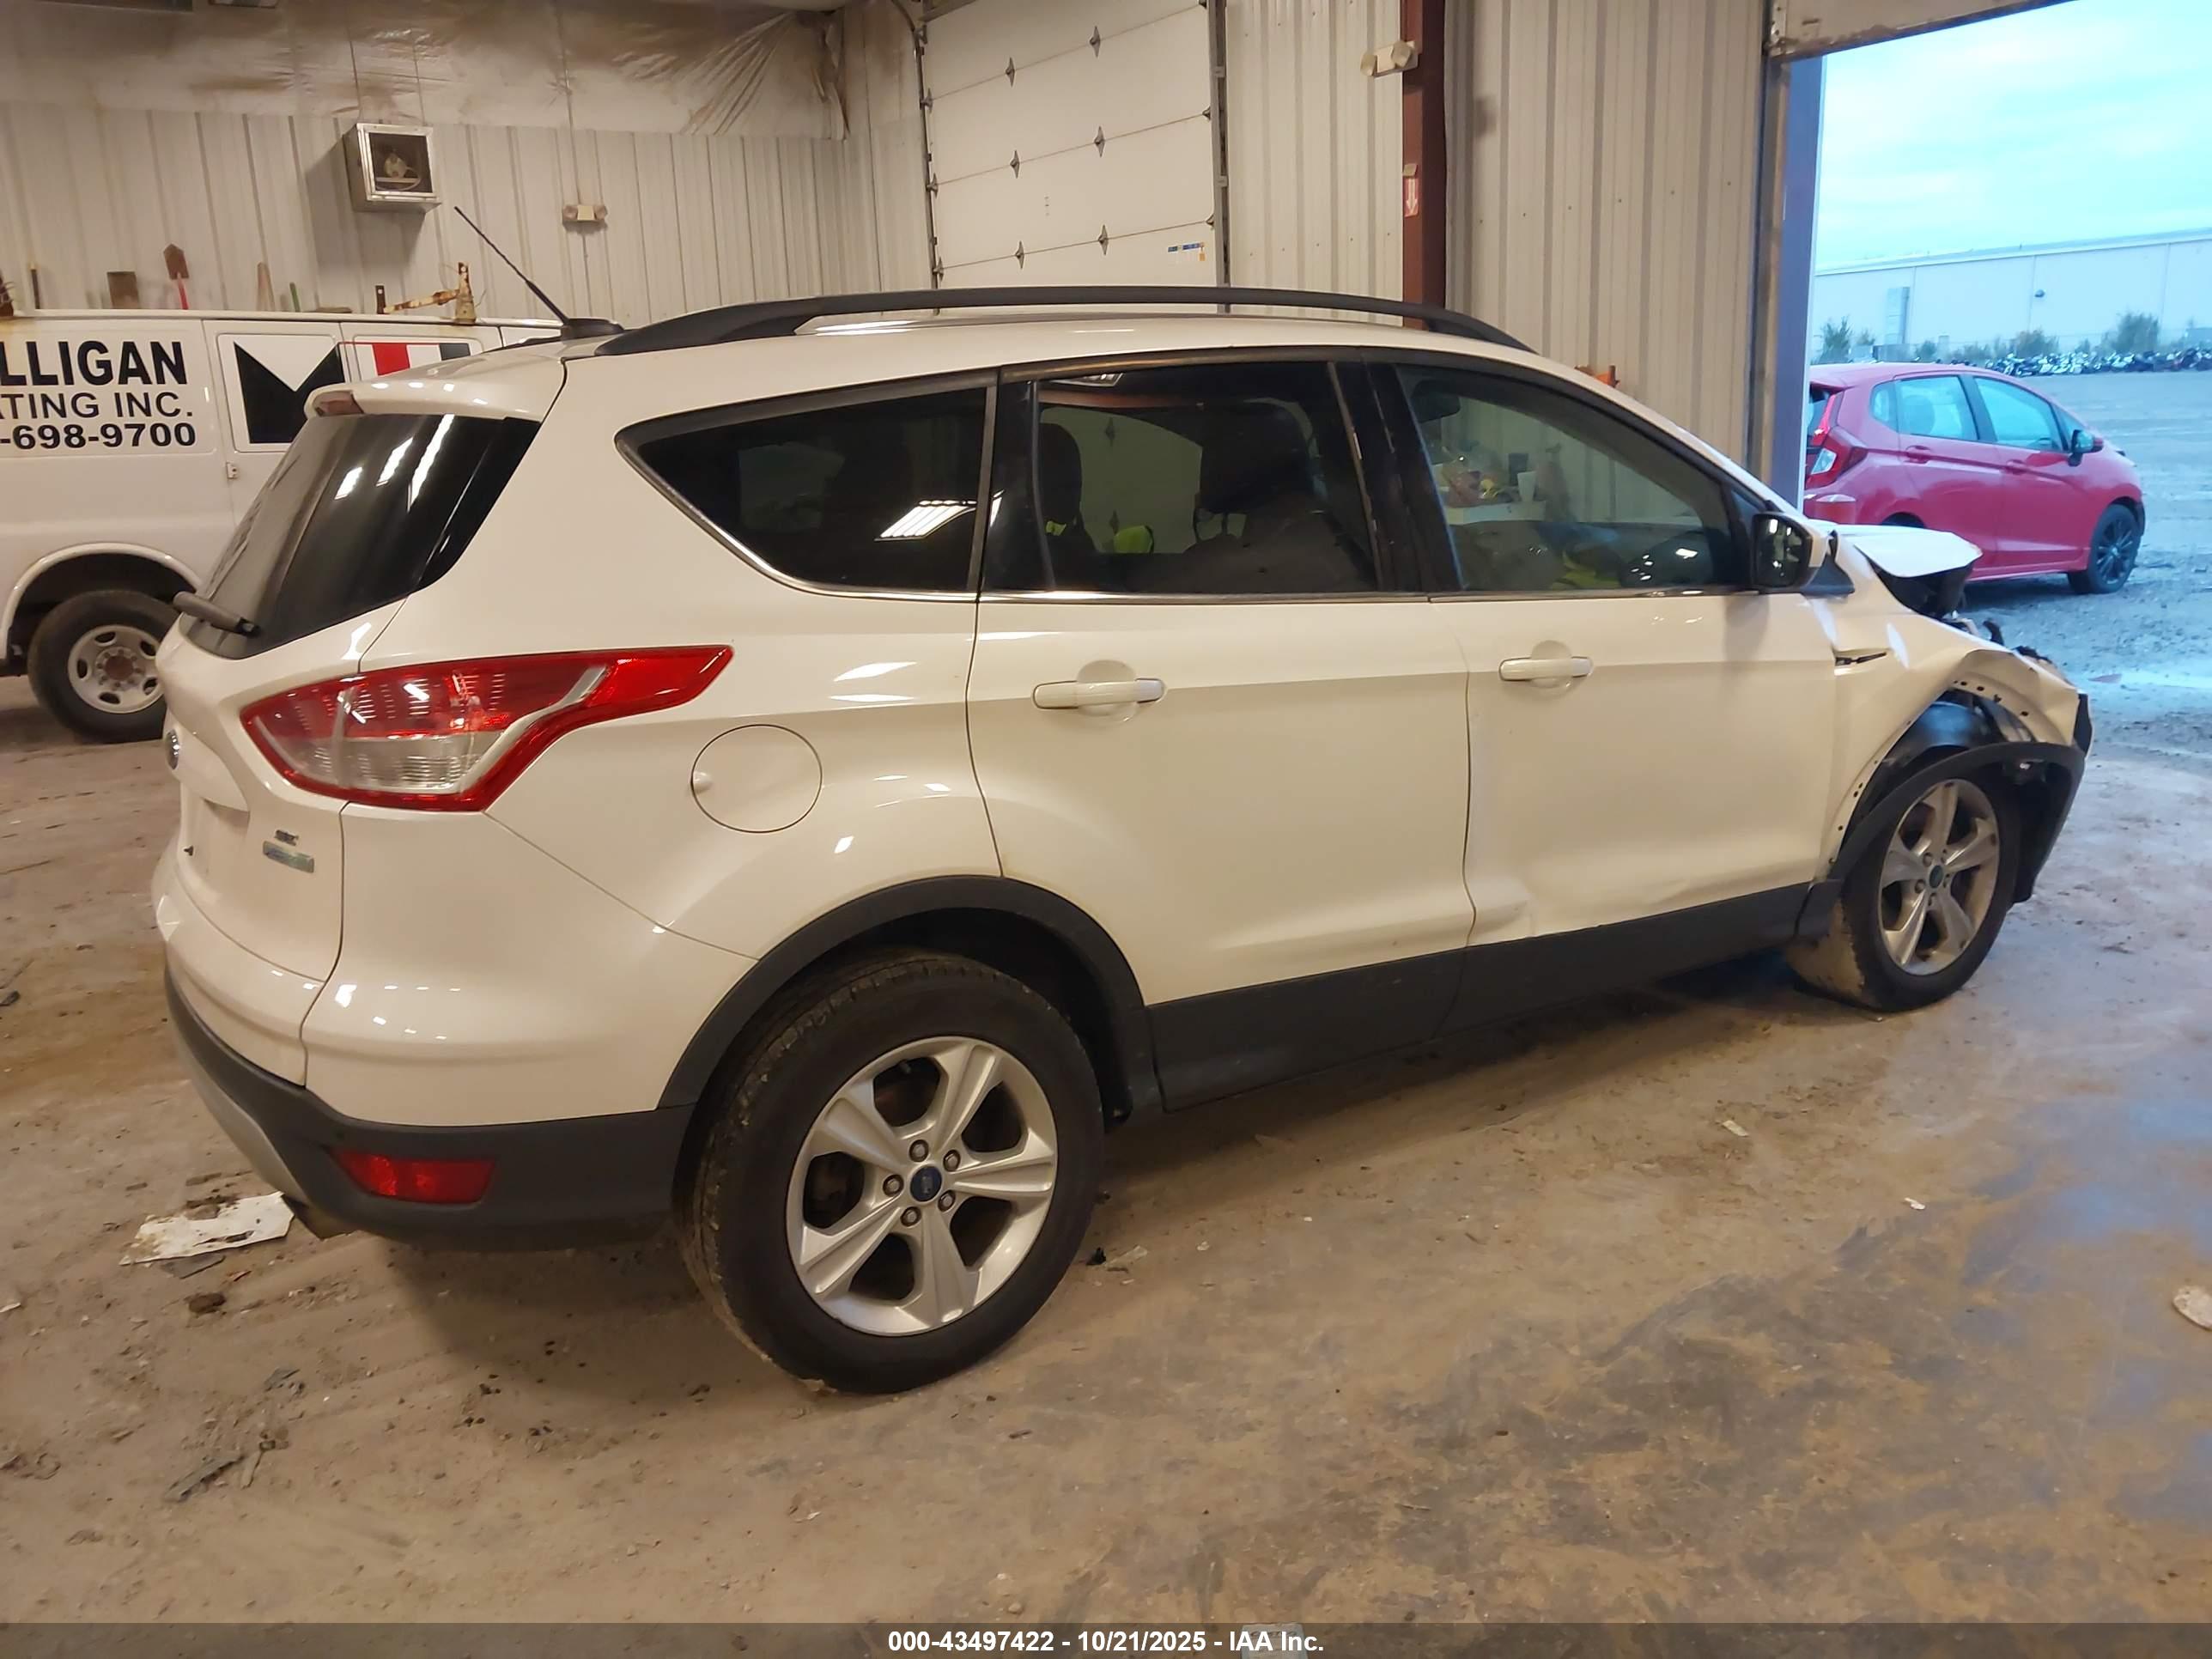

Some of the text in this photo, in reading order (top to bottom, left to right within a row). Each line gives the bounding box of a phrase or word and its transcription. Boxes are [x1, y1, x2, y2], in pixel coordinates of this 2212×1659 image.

[0, 340, 188, 386] LLIGAN
[0, 392, 193, 420] TING INC.
